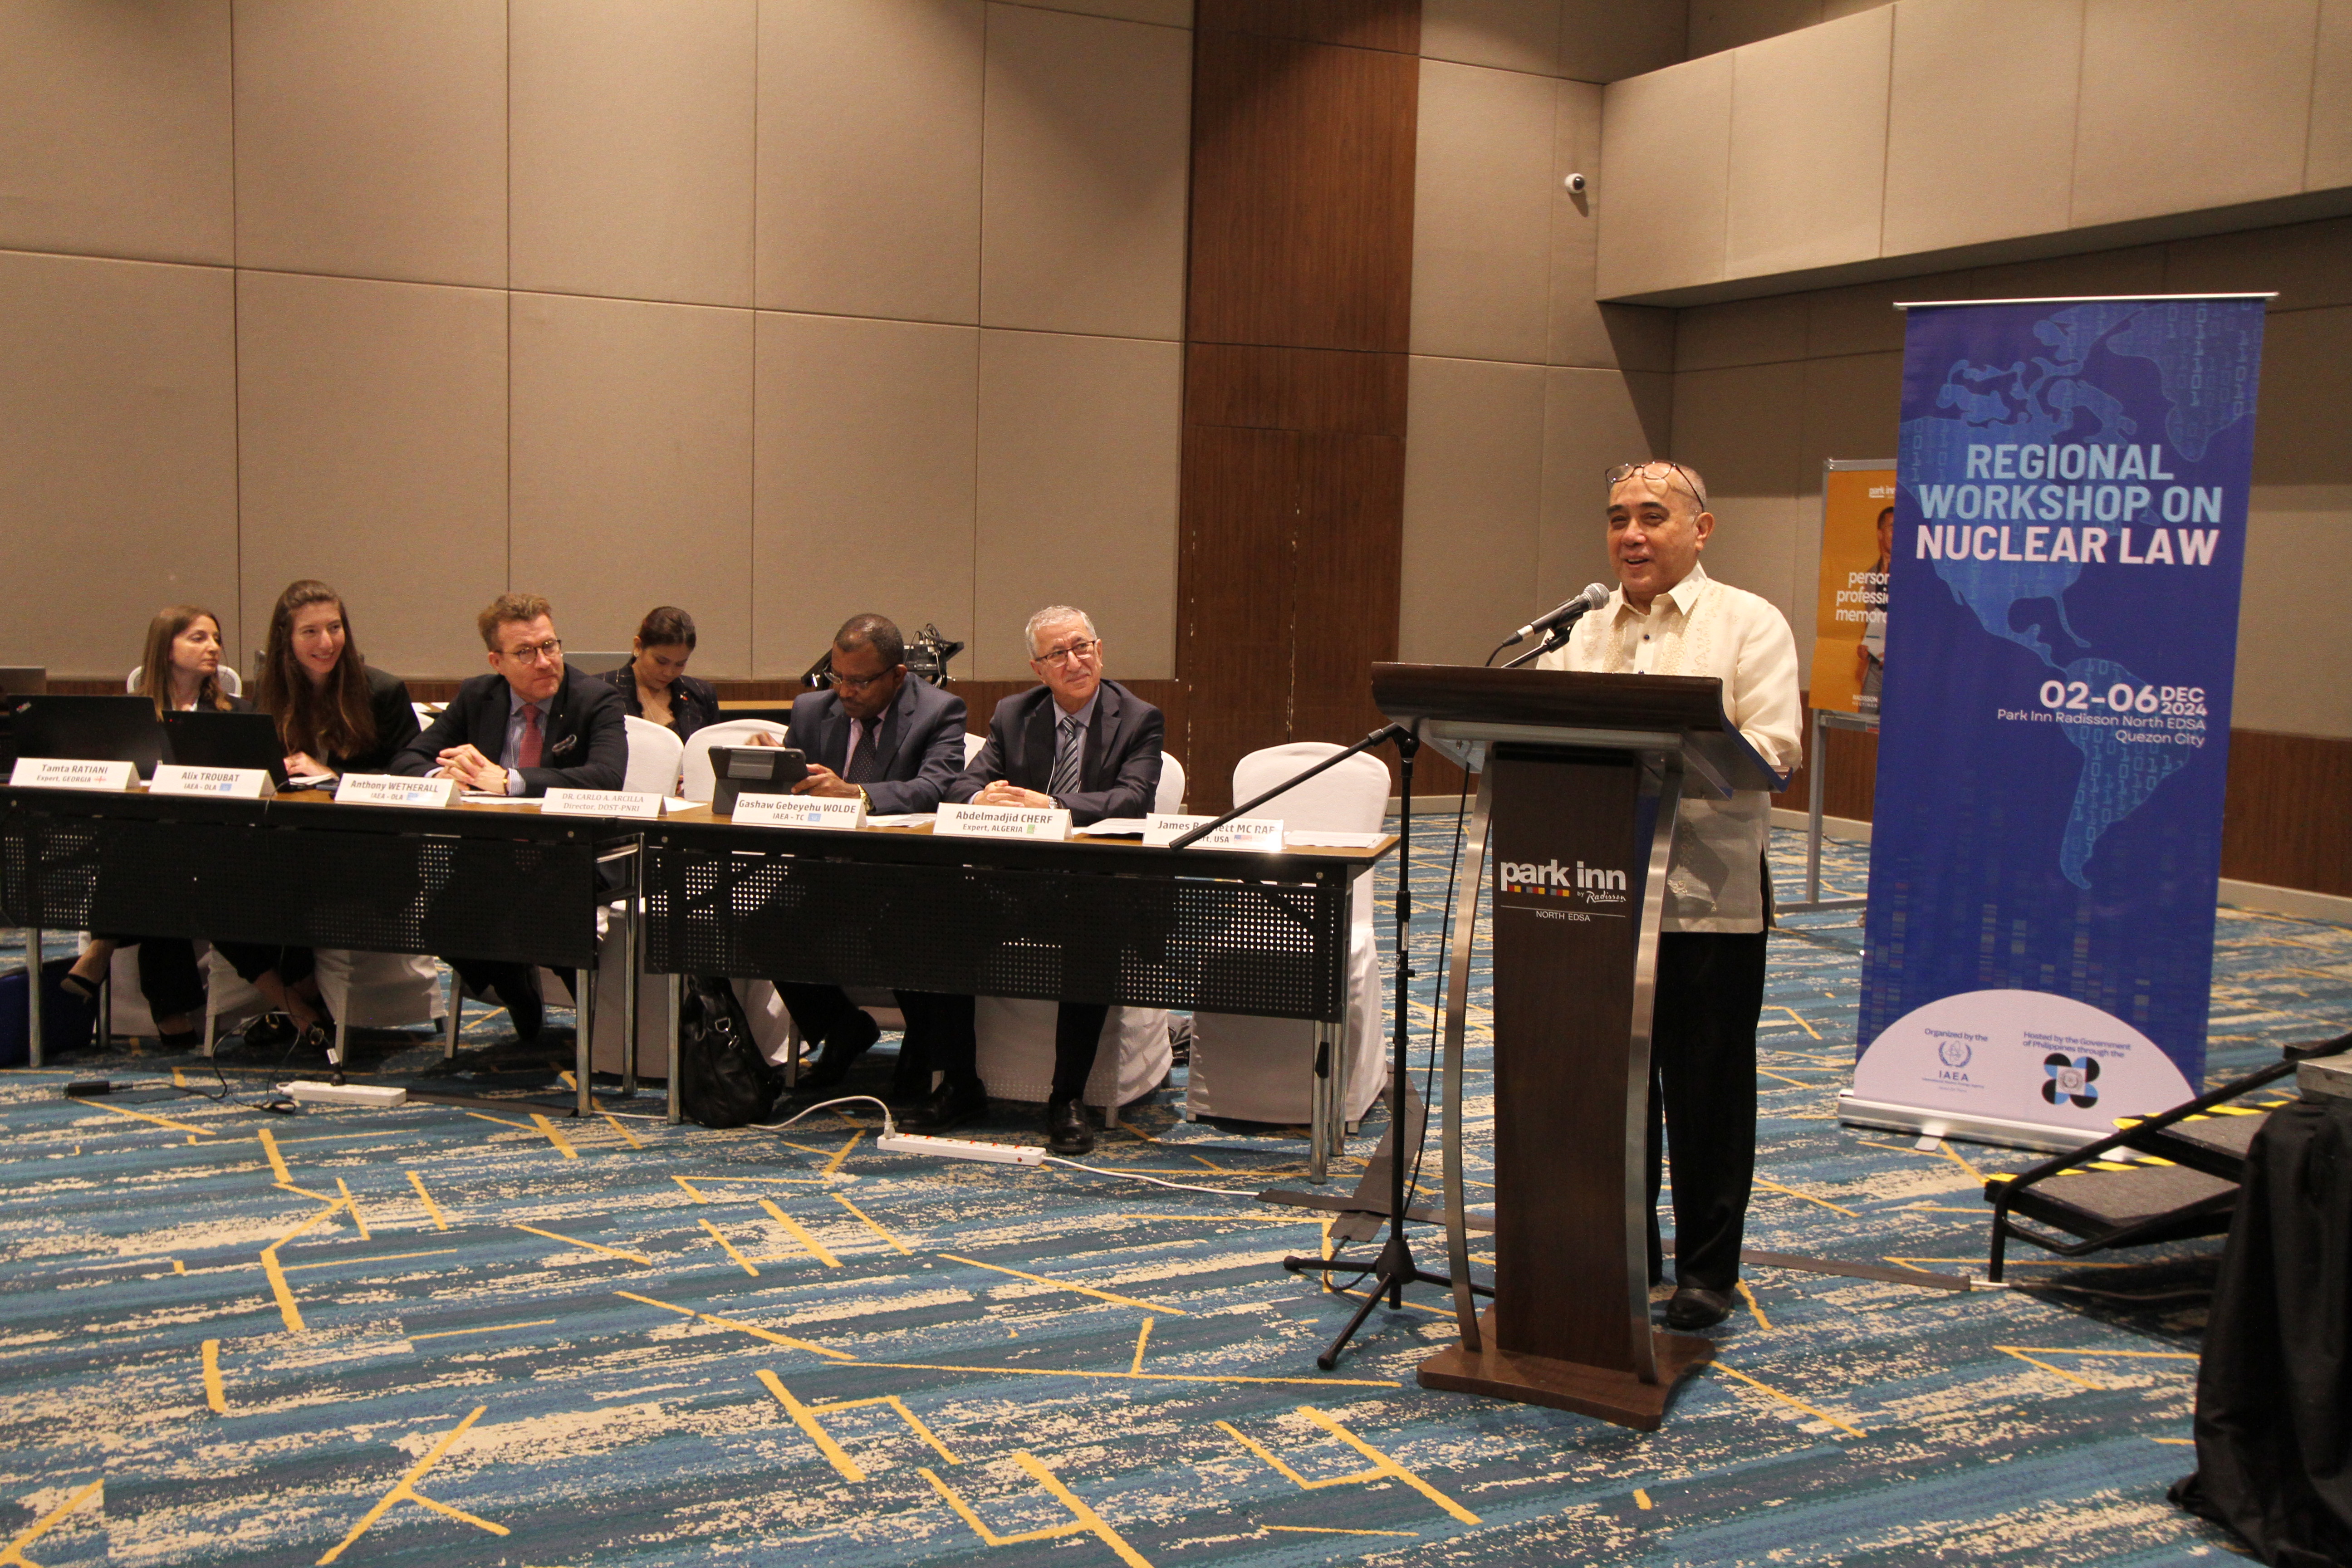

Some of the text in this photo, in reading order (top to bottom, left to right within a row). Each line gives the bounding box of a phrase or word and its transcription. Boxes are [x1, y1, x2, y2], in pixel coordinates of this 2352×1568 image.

[1966, 444, 2174, 480] REGIONAL
[1918, 484, 2223, 523] WORKSHOP ON
[1916, 525, 2220, 566] NUCLEAR LAW
[2040, 680, 2159, 713] 02-06
[2160, 686, 2205, 703] DEC
[2161, 701, 2208, 717] 2024
[1998, 709, 2206, 730] Park Inn Radisson North EDSA
[2115, 730, 2205, 748] Quezon City
[42, 764, 108, 774] Tamta RATIANI
[181, 772, 240, 782] Alix TROUBAT
[351, 780, 438, 793] Anthony WETHERALL
[564, 803, 596, 811] Director,
[739, 799, 857, 813] Gashaw Gebeyehu WOLDE
[956, 811, 1053, 824] Abdelmadjid CHERF
[963, 823, 1023, 833] Expert, ALGERIA
[1157, 820, 1190, 830] James
[1236, 824, 1252, 833] MC
[1500, 859, 1626, 892] park inn
[1586, 890, 1626, 904] Radisson
[1536, 910, 1590, 922] NORTH EDSA
[1925, 1028, 1962, 1038] Organized
[1964, 1033, 1974, 1041] by
[2024, 1032, 2053, 1041] Hosted
[2054, 1035, 2064, 1044] by
[2080, 1038, 2131, 1050] Government
[2033, 1041, 2076, 1052] Philippines
[2078, 1047, 2109, 1057] through
[1939, 1070, 1969, 1082] IAEA
